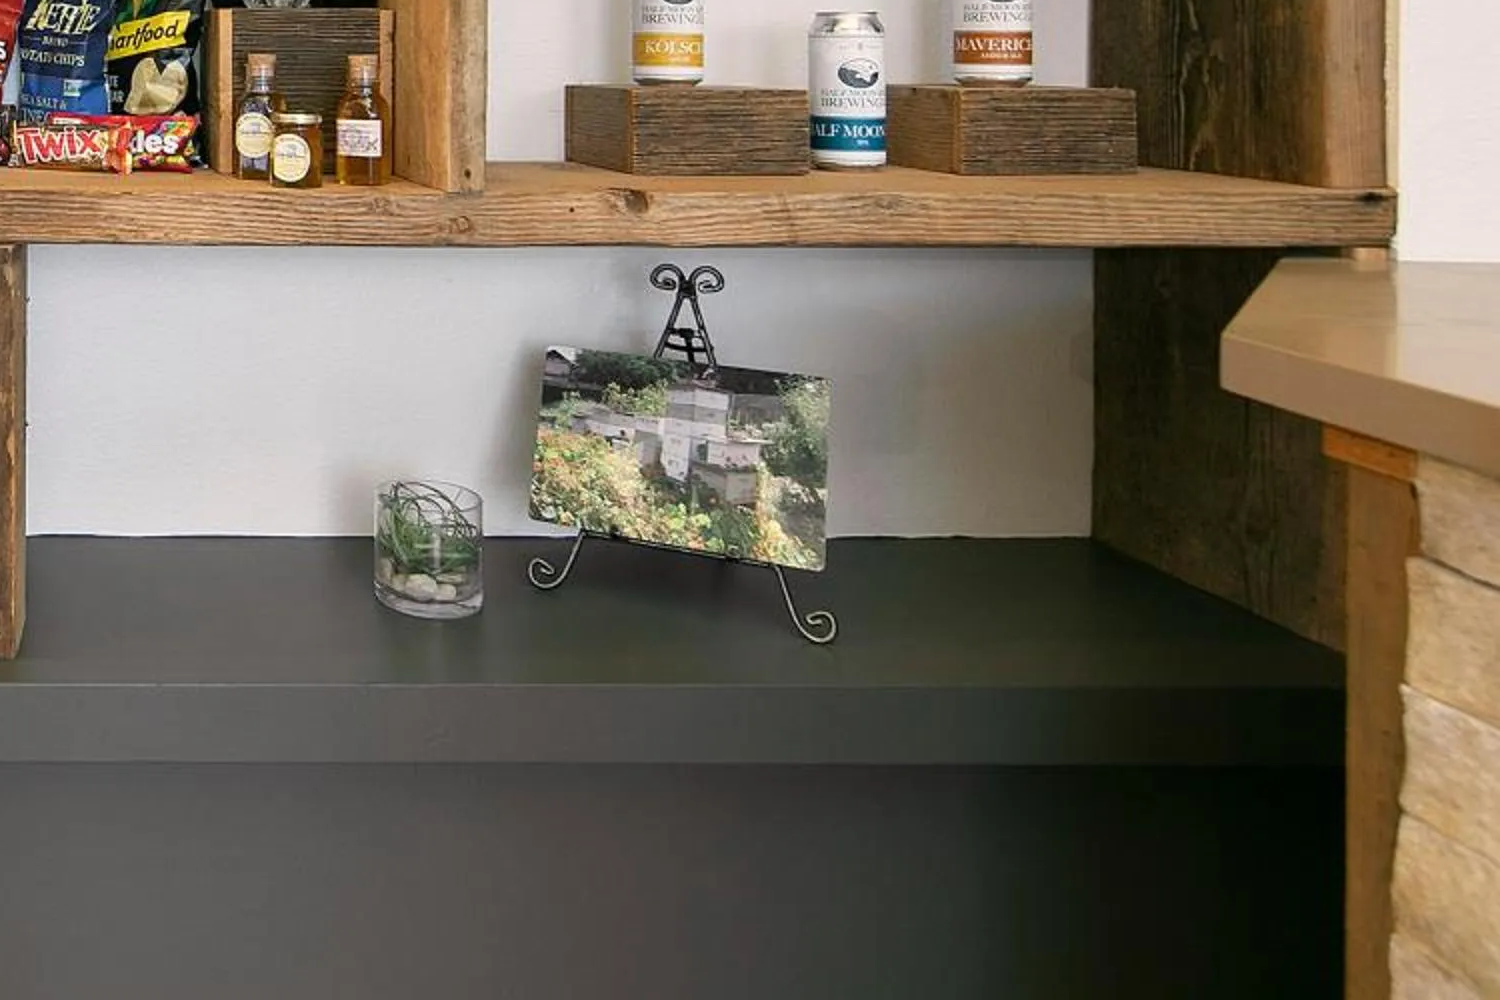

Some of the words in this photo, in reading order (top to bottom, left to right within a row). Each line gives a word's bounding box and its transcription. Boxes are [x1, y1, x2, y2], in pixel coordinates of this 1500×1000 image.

[963, 11, 1027, 23] BREWING
[111, 20, 180, 51] artfood
[814, 123, 841, 137] ALF
[17, 128, 102, 163] Twix
